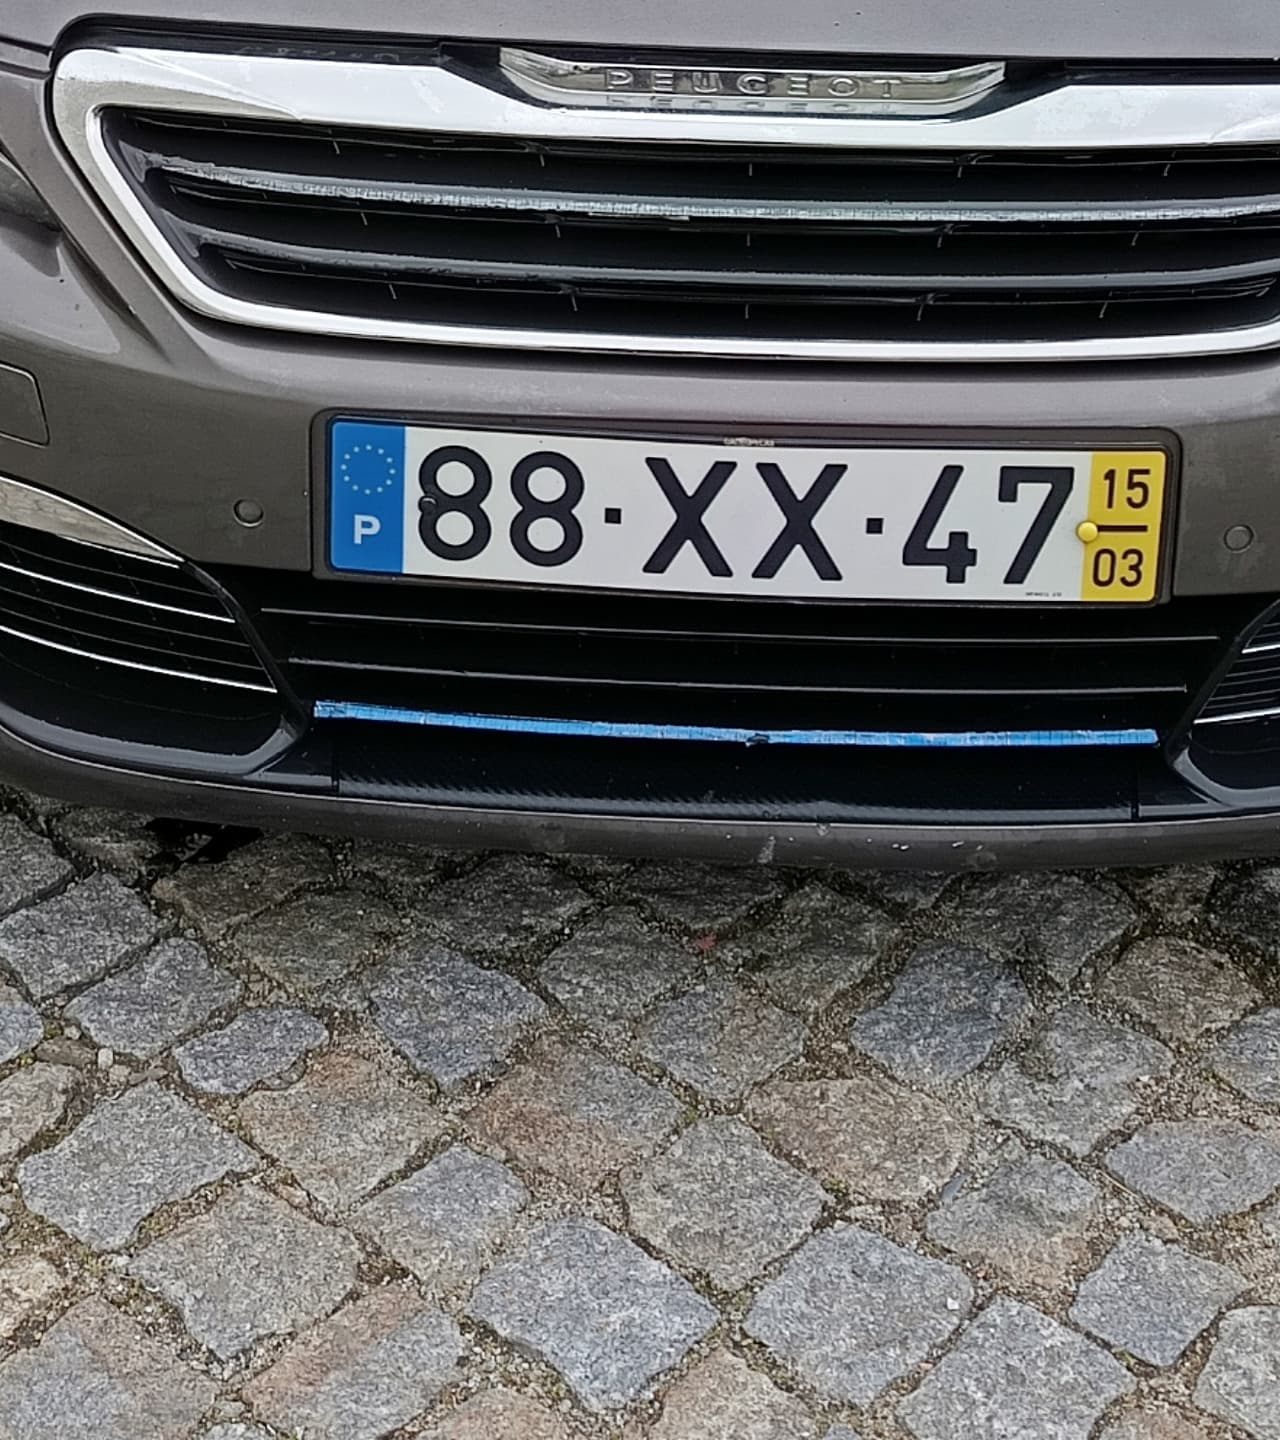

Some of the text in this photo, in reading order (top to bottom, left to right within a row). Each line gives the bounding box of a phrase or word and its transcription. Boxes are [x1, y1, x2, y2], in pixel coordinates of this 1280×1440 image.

[605, 70, 902, 100] PEUGEOT
[1103, 468, 1152, 510] 15
[353, 513, 381, 545] P
[1092, 547, 1145, 588] 03
